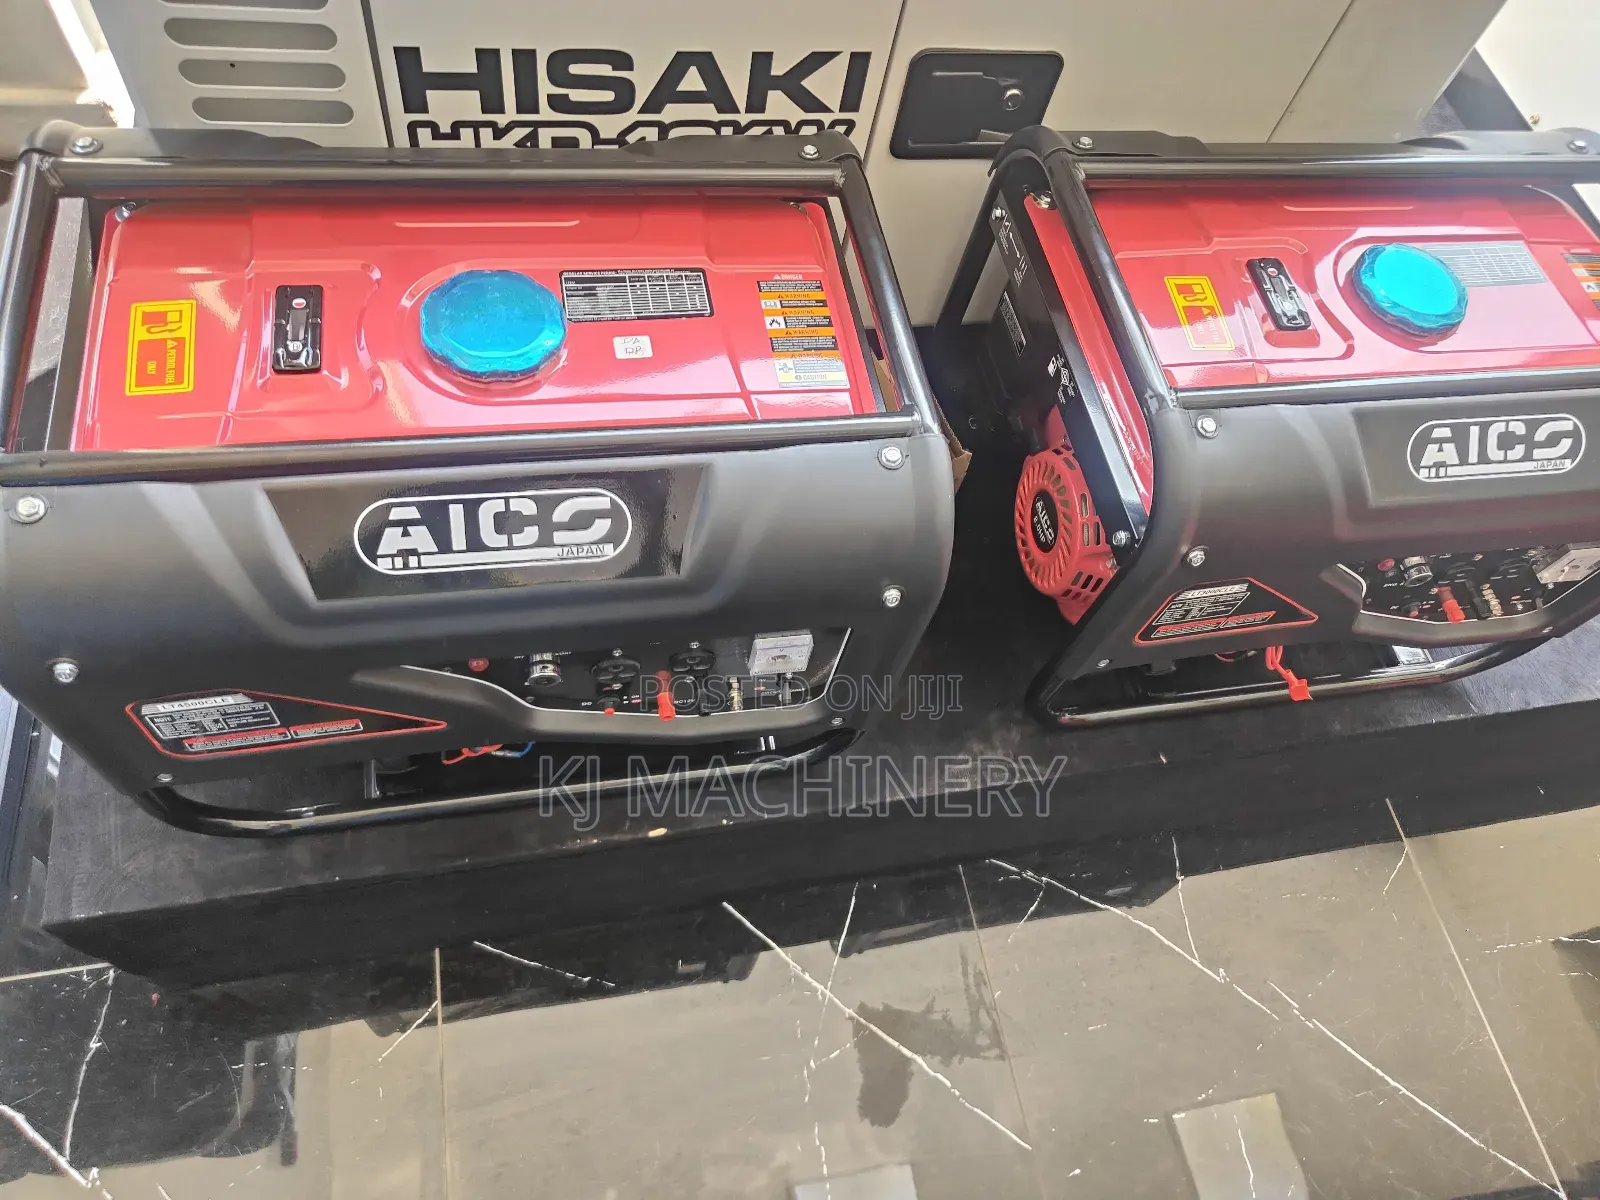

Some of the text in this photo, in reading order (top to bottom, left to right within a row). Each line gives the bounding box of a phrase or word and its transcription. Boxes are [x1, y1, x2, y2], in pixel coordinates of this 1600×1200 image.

[393, 46, 872, 115] HISAKI
[165, 349, 176, 384] PETROL FUEL
[1423, 420, 1574, 469] AICS
[1533, 460, 1566, 469] JAPAN
[376, 495, 612, 558] AICS
[556, 544, 607, 558] JAPAN
